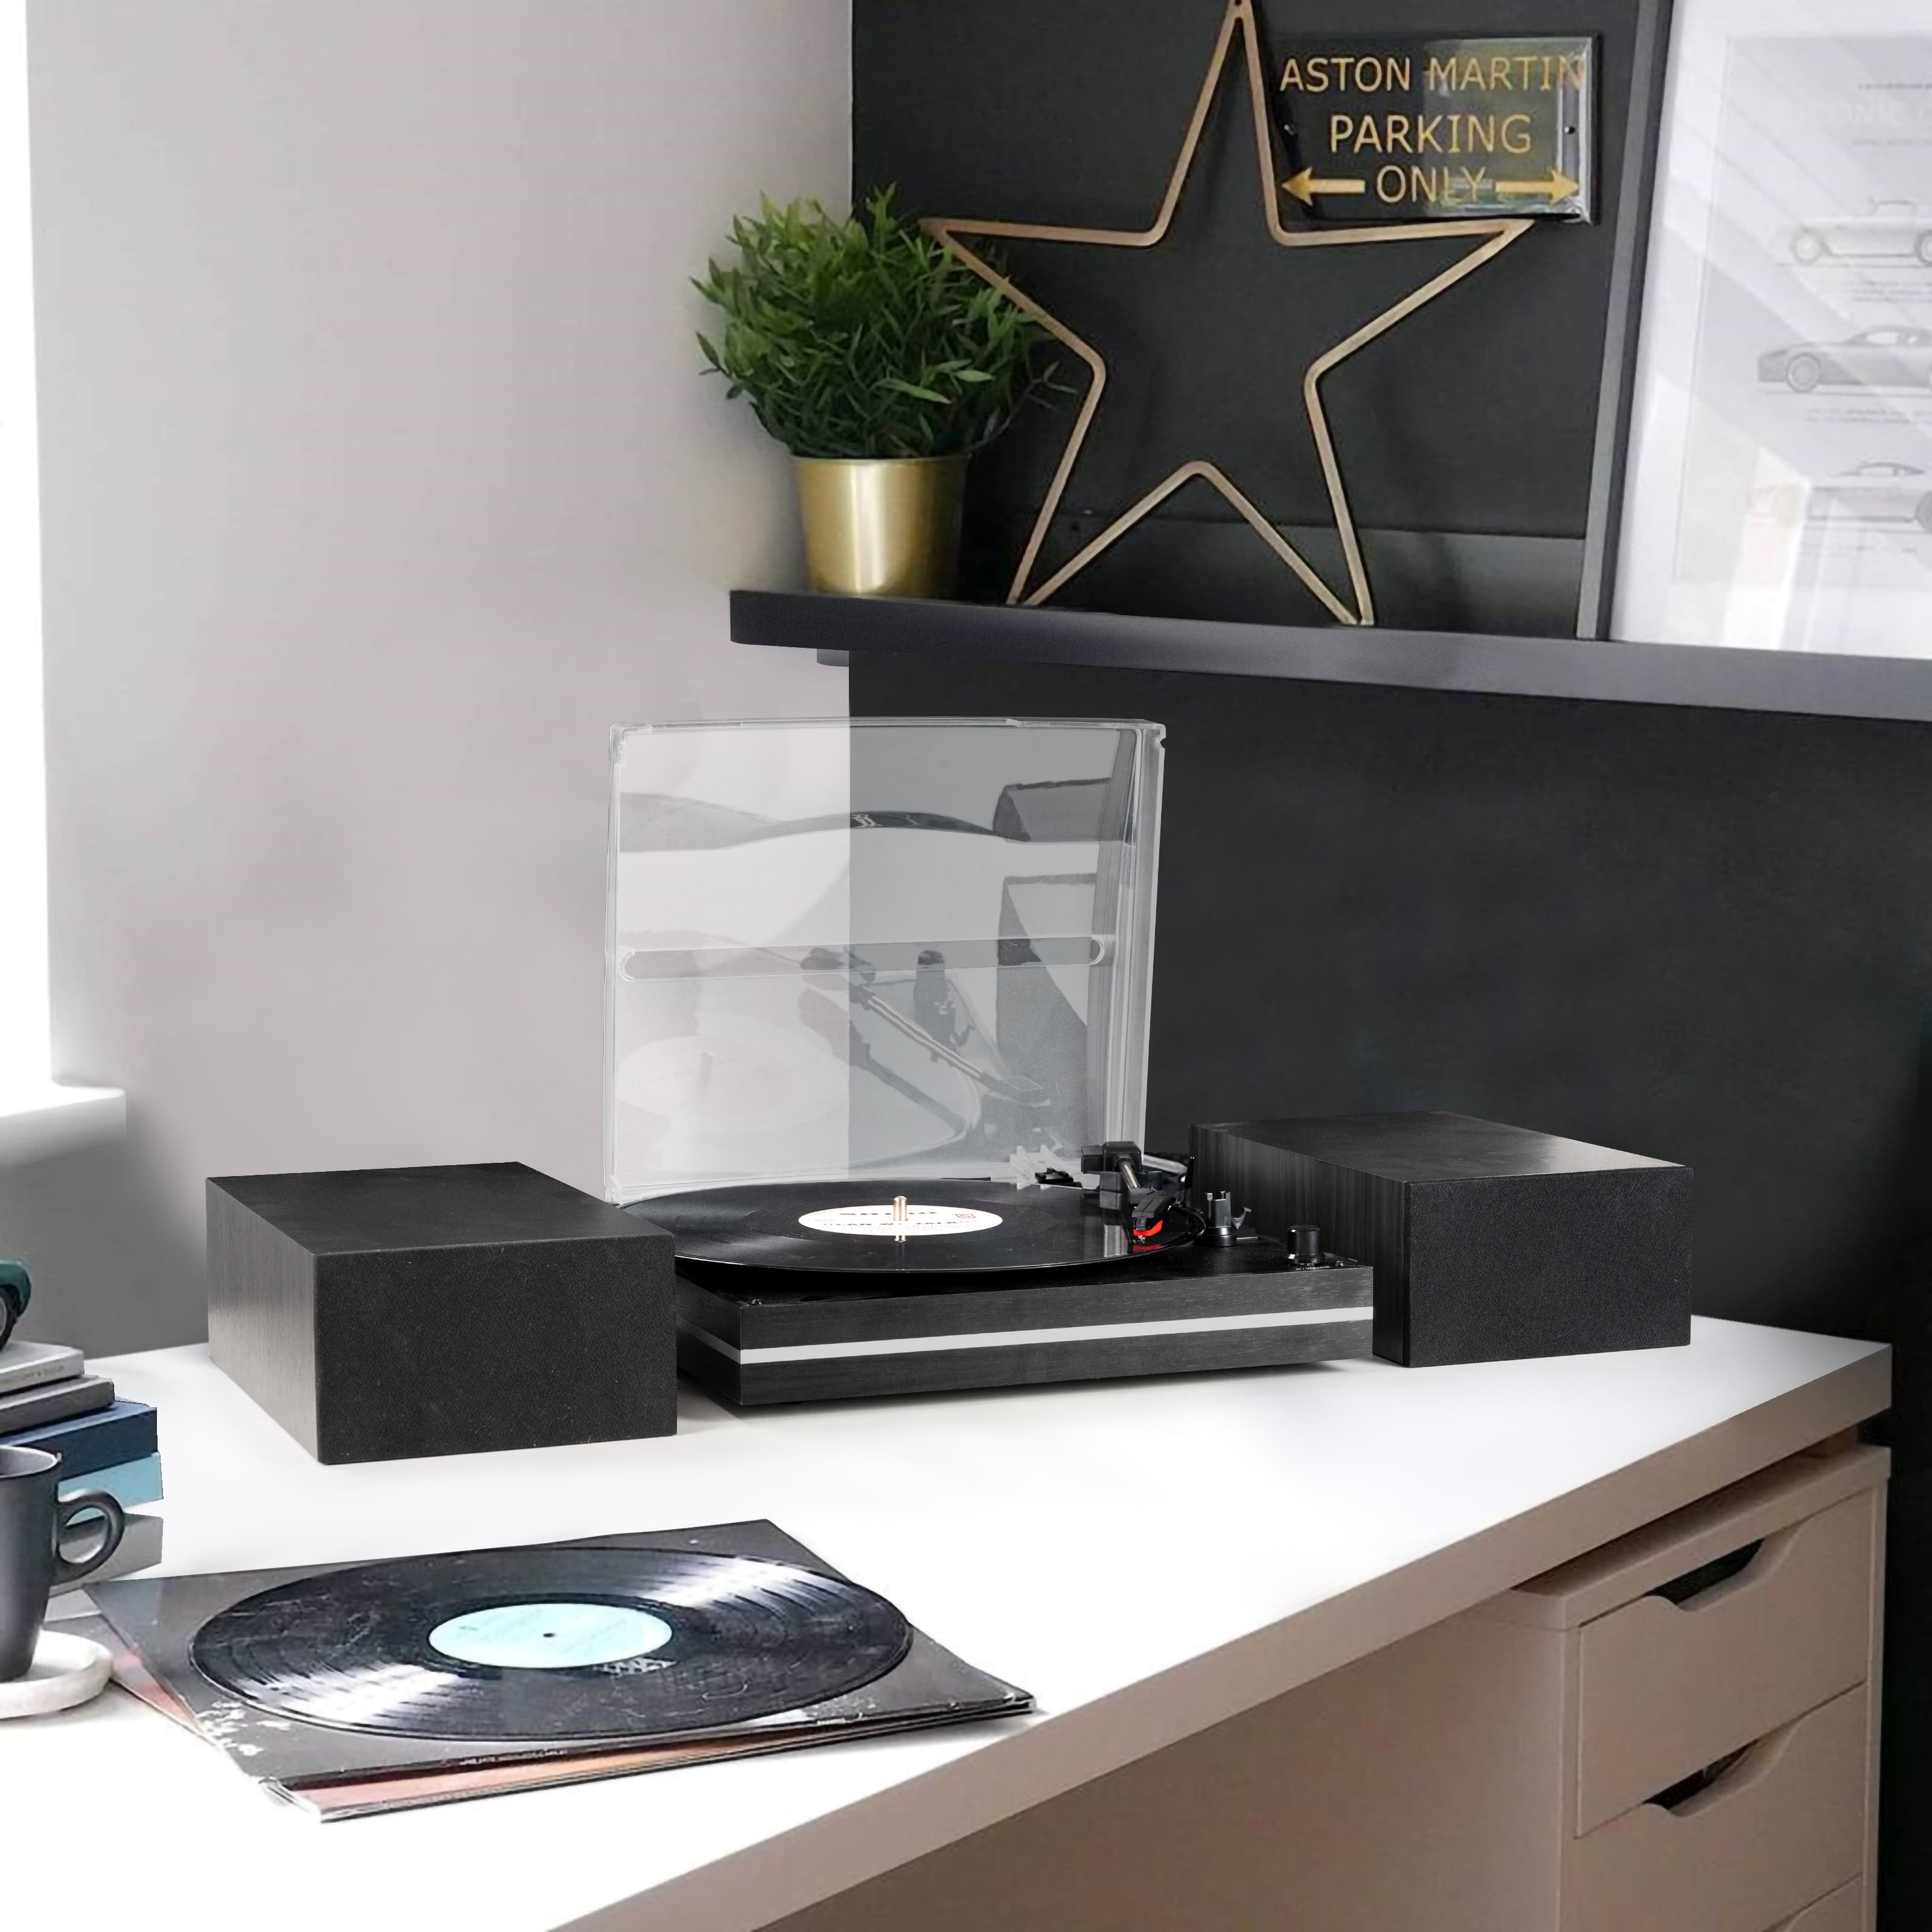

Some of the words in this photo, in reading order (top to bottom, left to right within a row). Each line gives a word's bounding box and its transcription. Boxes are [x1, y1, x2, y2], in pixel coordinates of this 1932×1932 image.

[1279, 57, 1411, 92] ASTON
[1428, 56, 1587, 91] MARTIN
[1329, 114, 1532, 154] PARKING
[1376, 165, 1487, 203] ONLY
